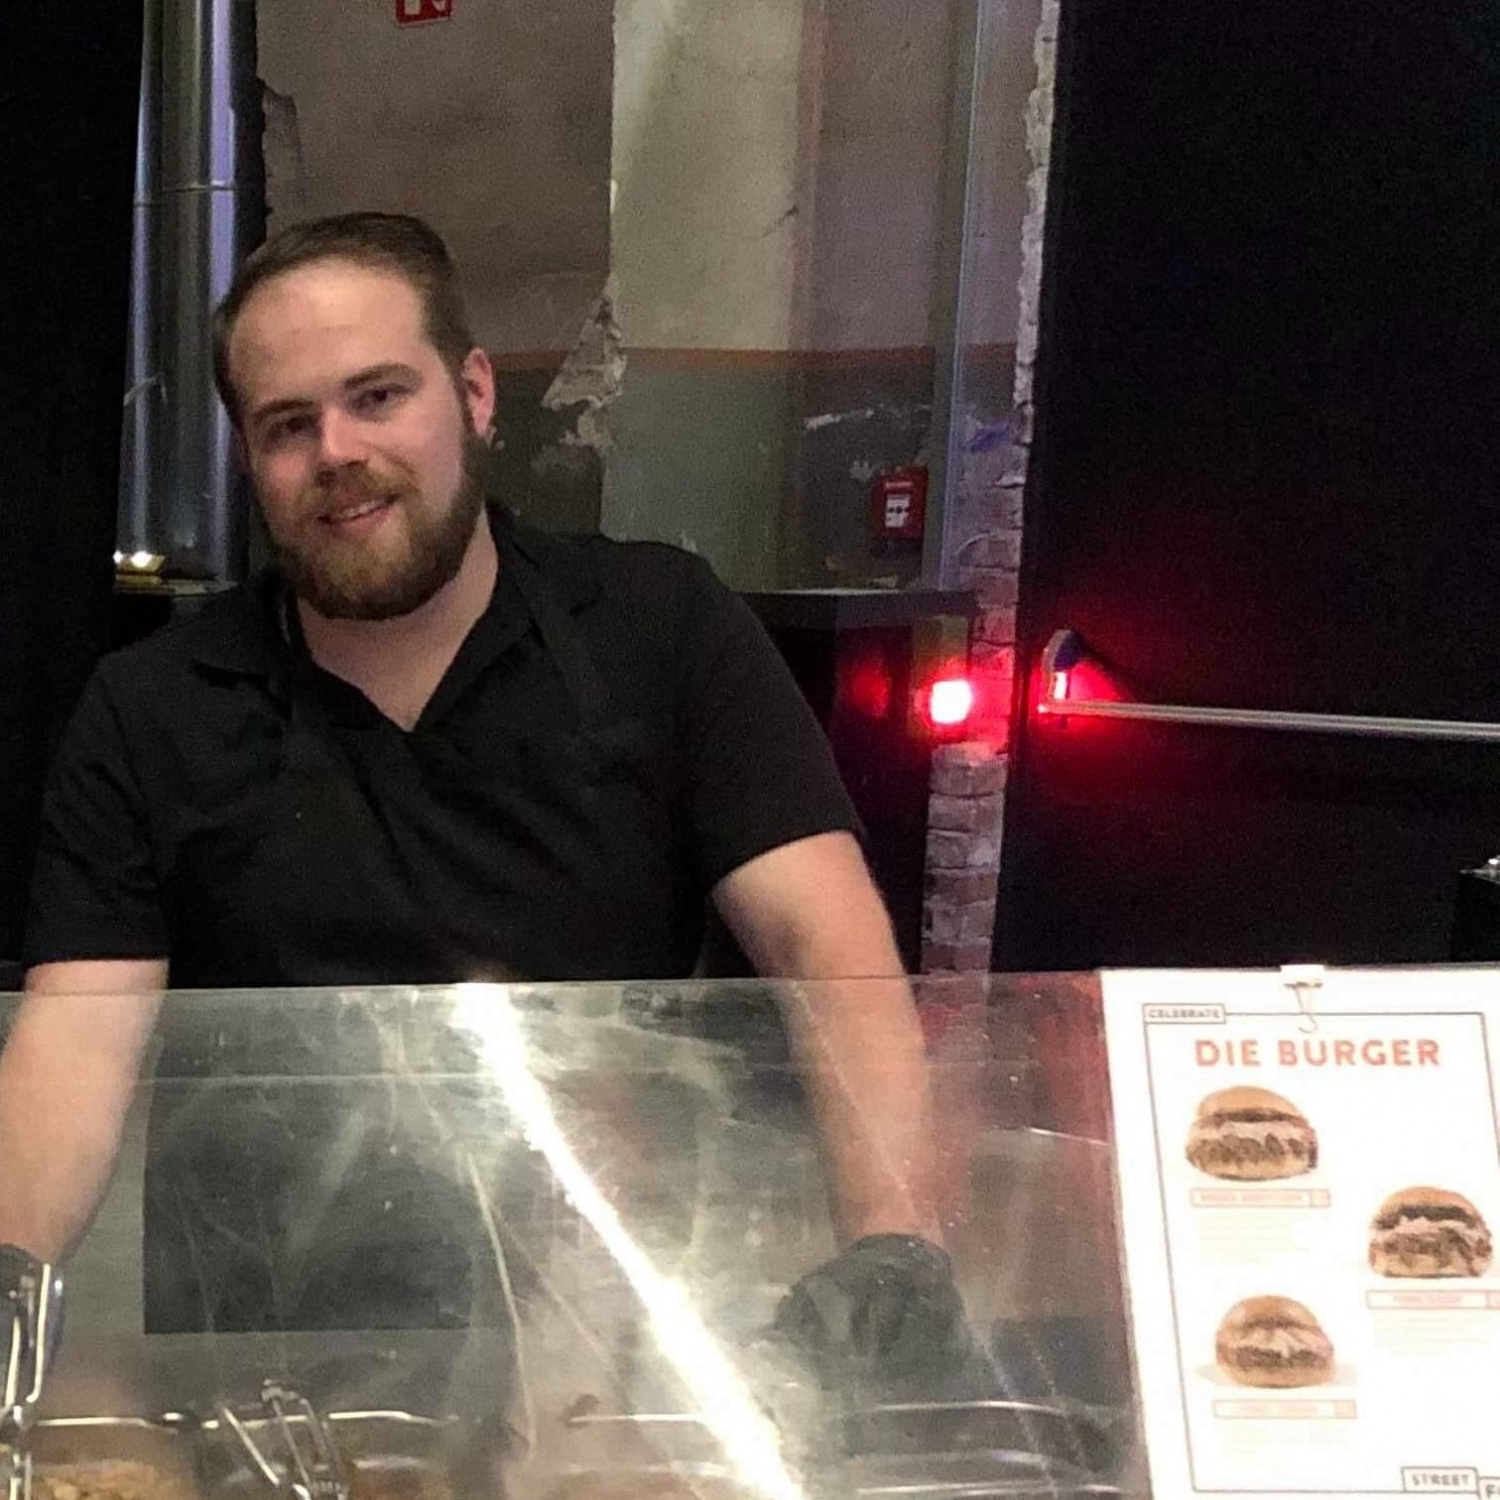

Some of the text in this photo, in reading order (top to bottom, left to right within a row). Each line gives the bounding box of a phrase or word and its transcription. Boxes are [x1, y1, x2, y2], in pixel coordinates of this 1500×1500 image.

[1194, 1038, 1441, 1067] DIE BURGER
[1411, 1473, 1470, 1486] STREET
